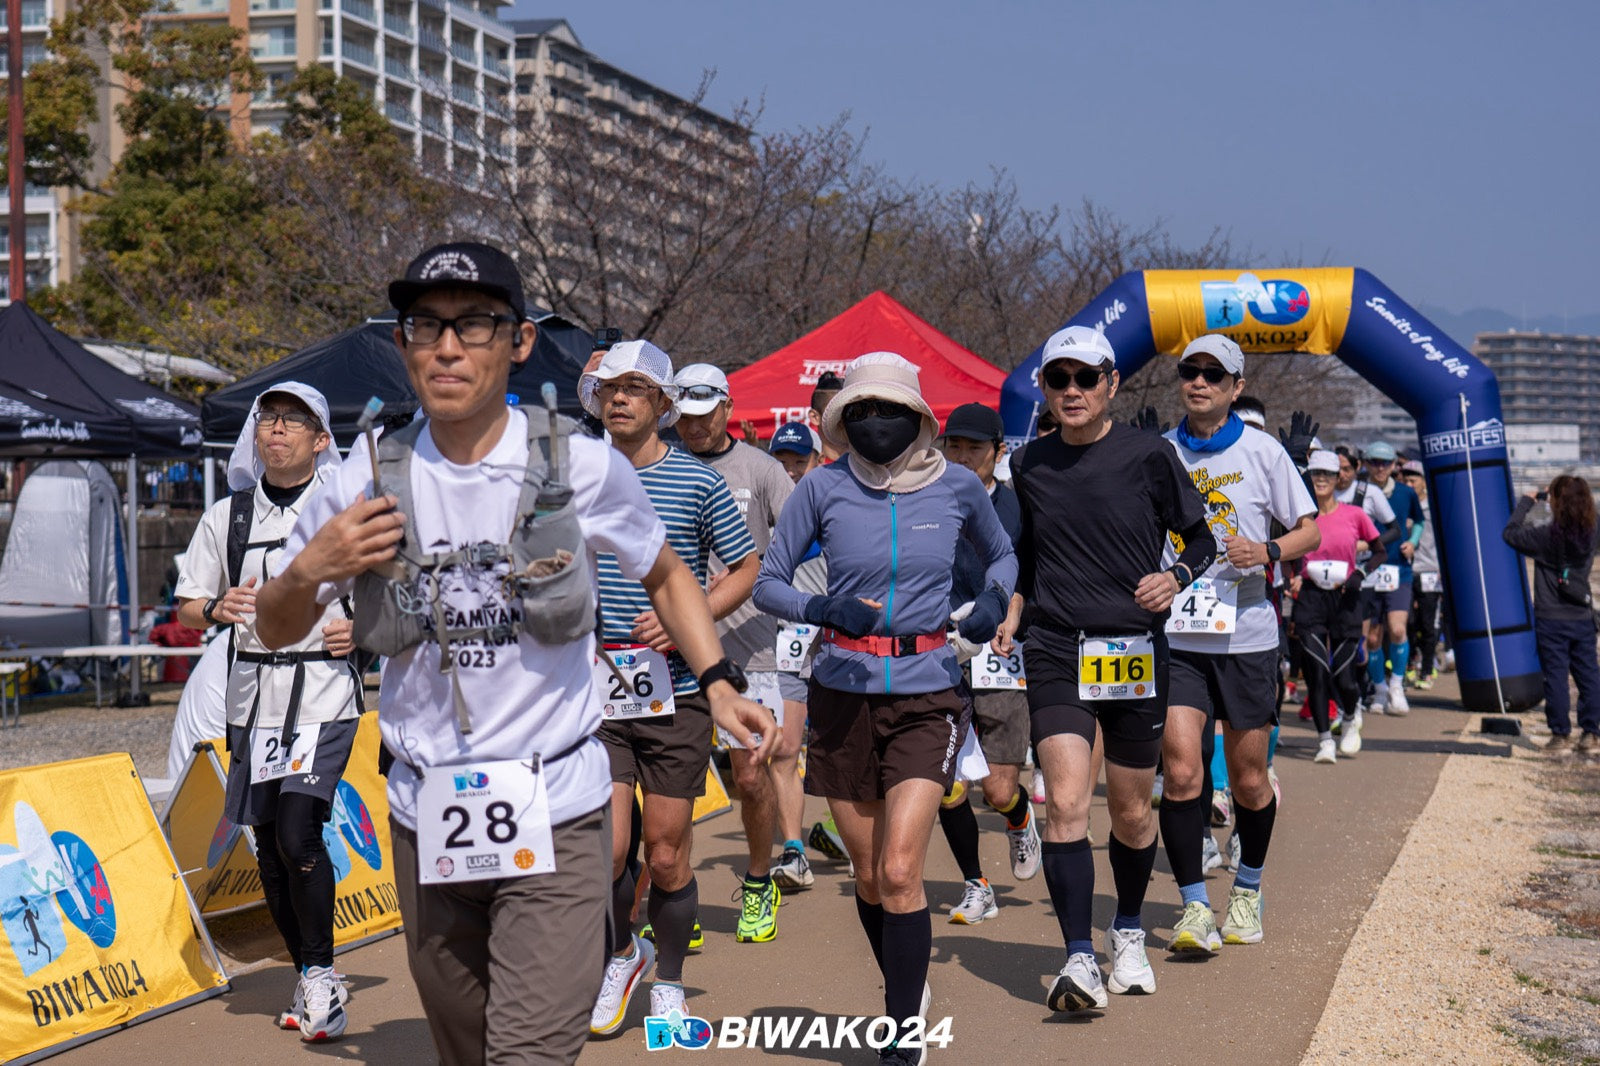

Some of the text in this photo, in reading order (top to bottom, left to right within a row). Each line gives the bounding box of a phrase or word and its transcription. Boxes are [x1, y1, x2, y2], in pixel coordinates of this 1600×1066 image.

[1105, 299, 1127, 324] life
[1421, 342, 1445, 362] my
[1443, 357, 1470, 379] life
[1199, 471, 1244, 494] GROOVE
[1323, 568, 1329, 581] 1
[1181, 595, 1221, 617] 47
[789, 640, 803, 657] 9
[986, 654, 1021, 674] 53
[1090, 657, 1145, 682] 116
[608, 671, 654, 700] 26
[442, 801, 518, 849] 28
[334, 882, 400, 930] BIWAKO
[26, 959, 149, 1027] BIWAKO24
